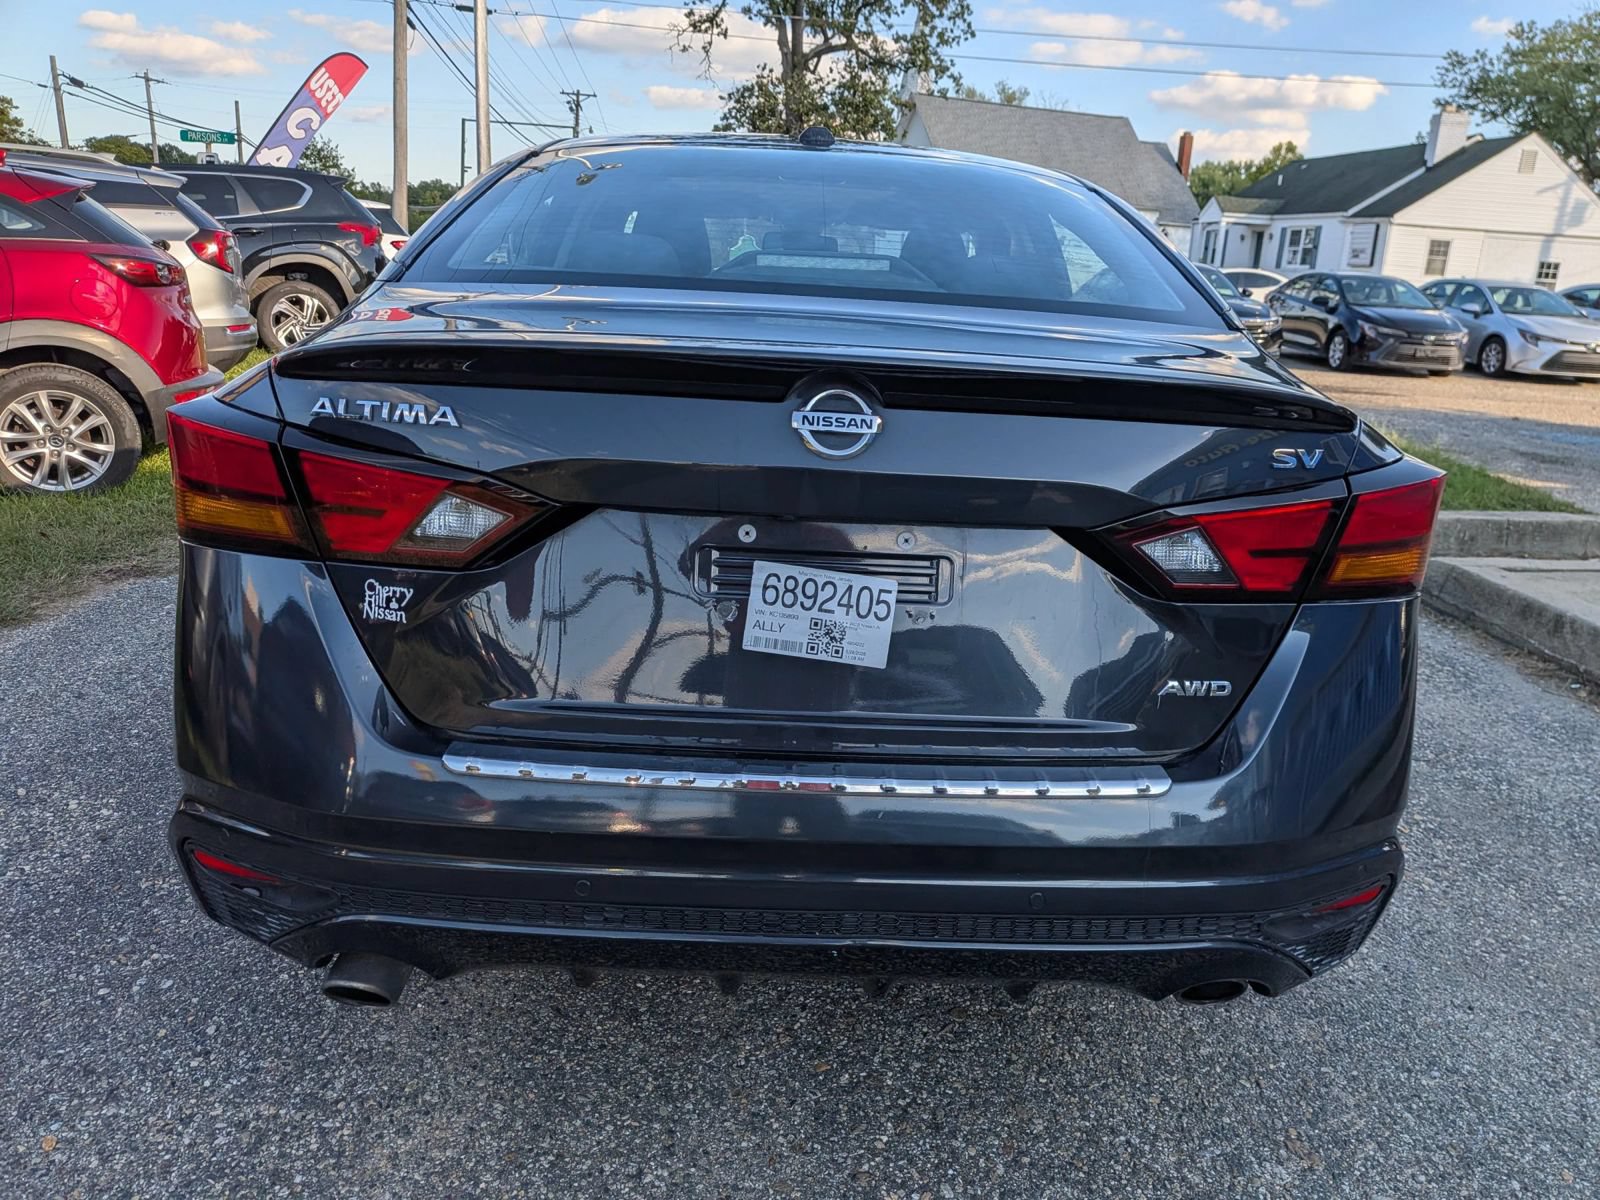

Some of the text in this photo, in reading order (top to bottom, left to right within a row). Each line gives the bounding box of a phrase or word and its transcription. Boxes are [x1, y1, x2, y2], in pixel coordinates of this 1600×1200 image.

[187, 131, 222, 142] PARSONS
[310, 397, 460, 427] ALTIMA
[801, 414, 873, 430] NISSAN
[1272, 448, 1324, 469] SV
[364, 578, 414, 607] Cherry
[761, 572, 893, 622] 6892405
[362, 602, 407, 624] Nissan
[752, 619, 786, 633] ALLY
[1158, 680, 1232, 696] AWD
